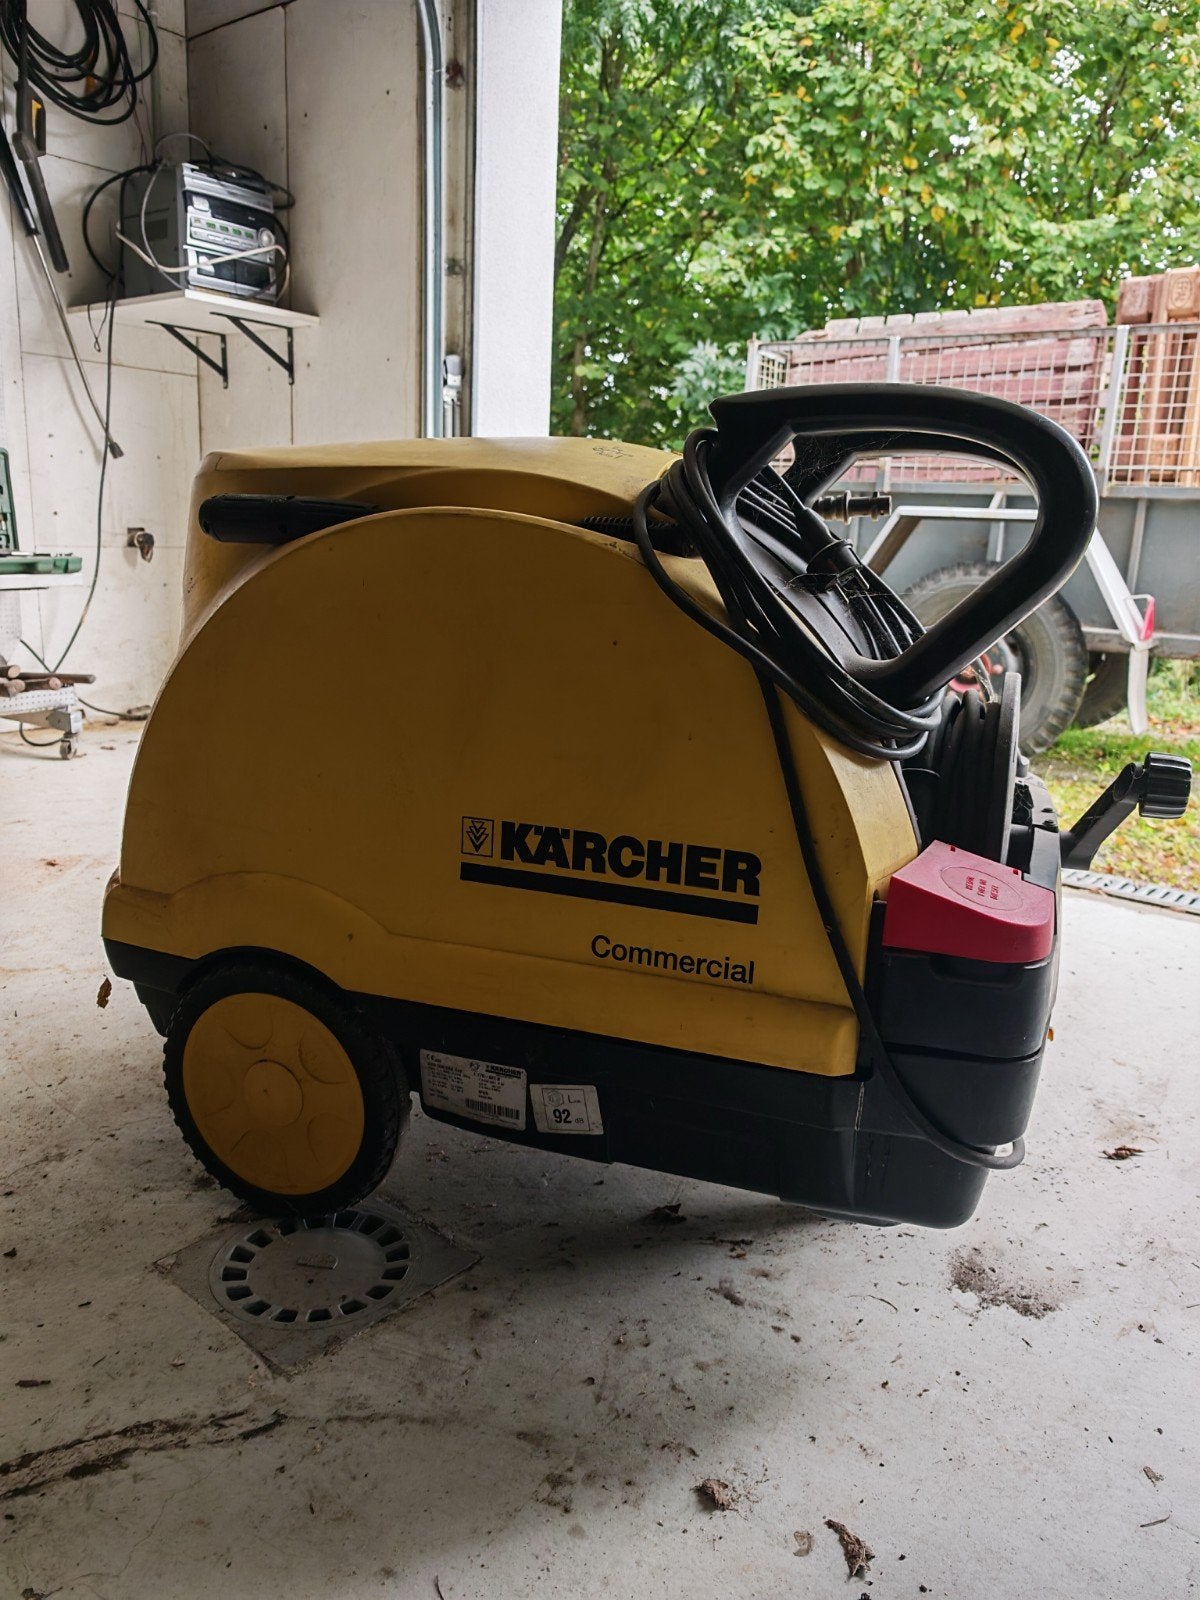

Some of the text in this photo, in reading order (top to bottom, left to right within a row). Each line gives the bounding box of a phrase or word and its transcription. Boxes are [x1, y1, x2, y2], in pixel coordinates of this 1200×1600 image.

[500, 820, 762, 896] KÄRCHER
[591, 934, 755, 984] Commercial
[553, 1108, 572, 1124] 92
